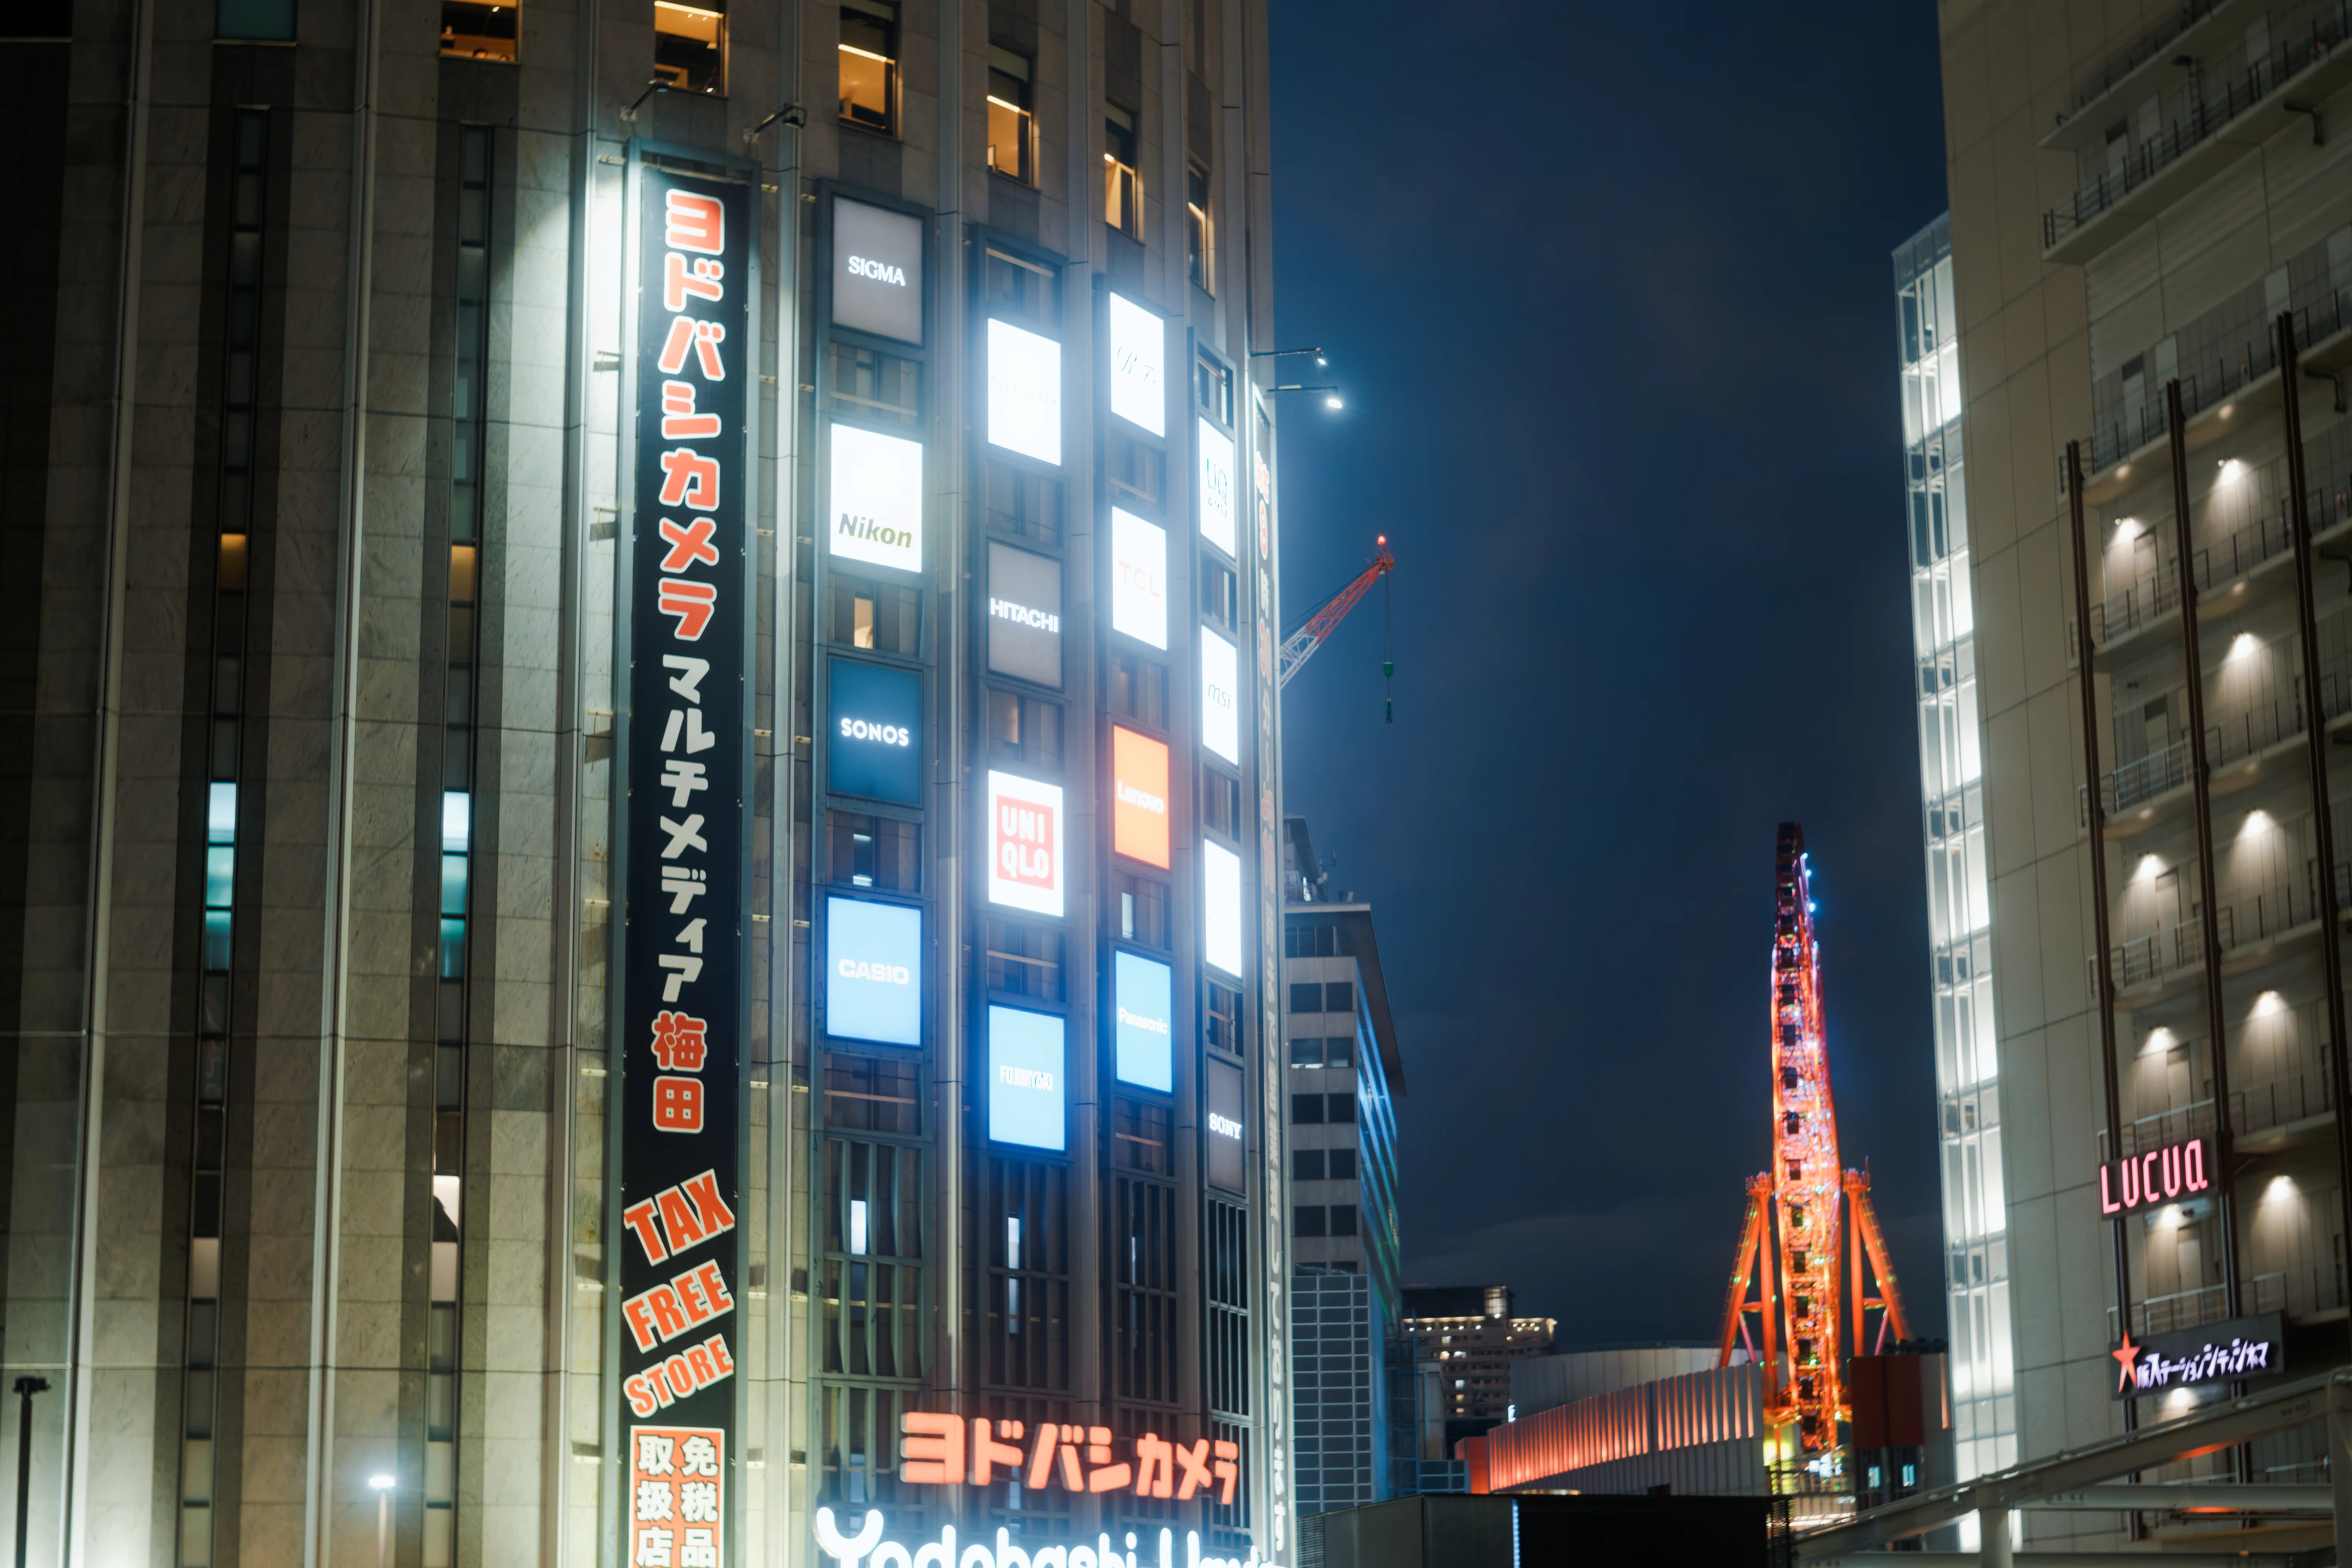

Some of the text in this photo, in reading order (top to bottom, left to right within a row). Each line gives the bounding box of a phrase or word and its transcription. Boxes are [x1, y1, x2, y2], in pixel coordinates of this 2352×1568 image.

[849, 255, 905, 286] SIGMA
[1207, 458, 1227, 506] UQ
[839, 513, 912, 548] Nikon
[1119, 560, 1160, 598] TCL
[991, 597, 1059, 632] HITACHI
[1208, 682, 1231, 710] msi
[841, 718, 909, 746] SONOS
[1118, 779, 1164, 814] Lenovo
[1002, 805, 1045, 843] UNI
[1002, 842, 1049, 879] QLO
[839, 958, 909, 984] CASIO
[1209, 1113, 1242, 1139] SONY
[2101, 1139, 2208, 1214] LUCUA
[623, 1168, 735, 1267] TAX
[622, 1259, 735, 1354] FREE
[623, 1333, 734, 1418] STORE
[900, 1412, 1238, 1505] ヨドバシカメラ
